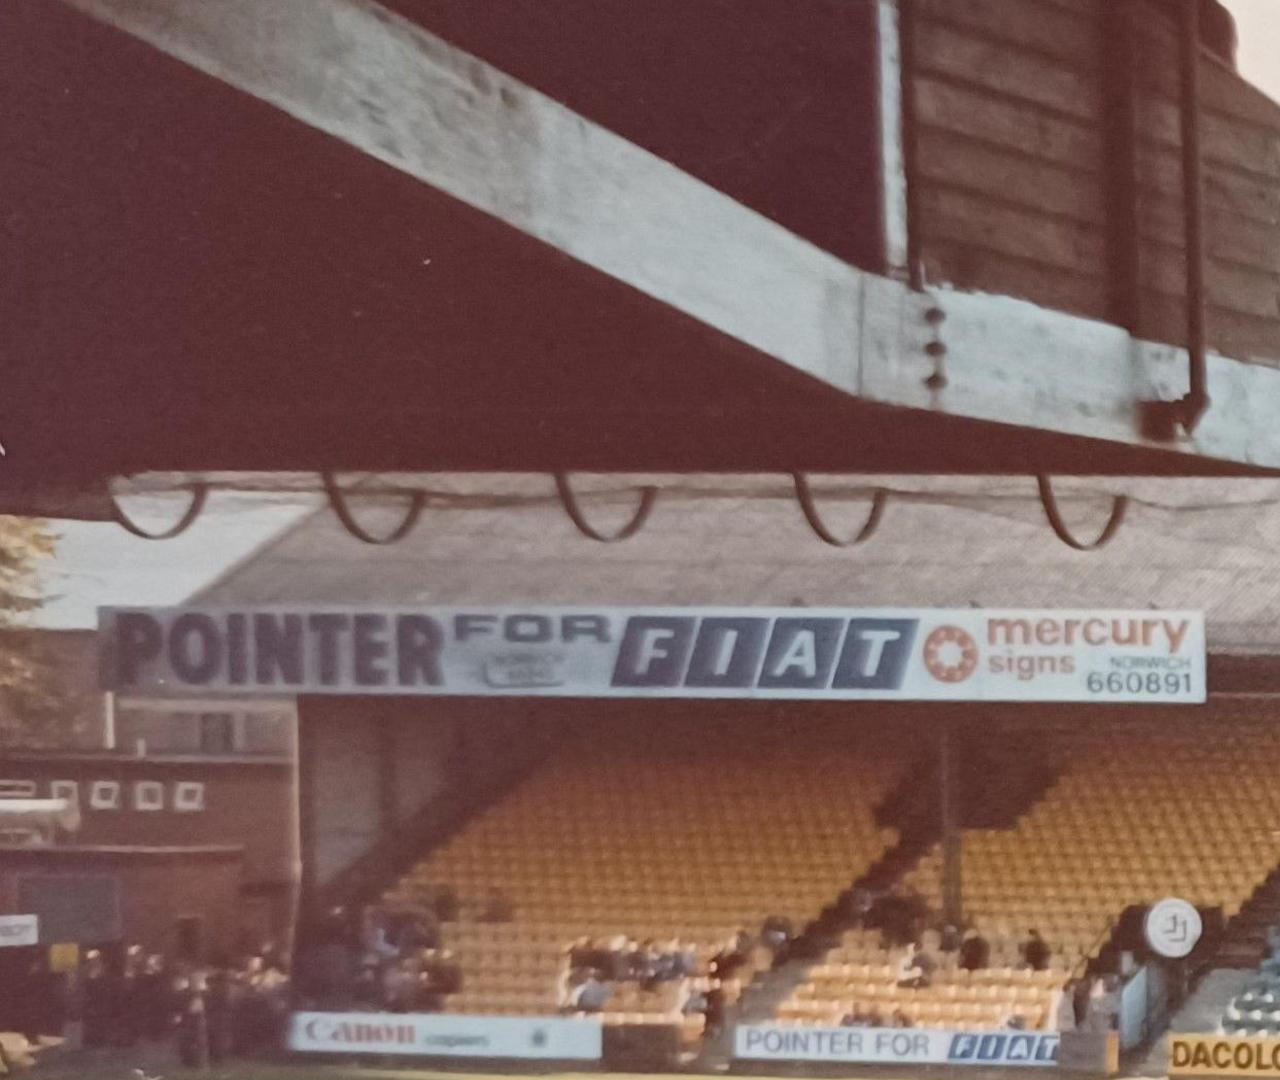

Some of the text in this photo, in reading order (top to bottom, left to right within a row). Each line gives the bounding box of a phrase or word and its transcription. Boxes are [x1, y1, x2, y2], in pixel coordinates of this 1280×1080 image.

[987, 618, 1189, 653] mercury
[114, 613, 444, 686] POINTER
[455, 614, 612, 643] FOR
[620, 621, 910, 684] FIAT
[1110, 656, 1191, 669] NORWICH
[988, 650, 1075, 681] signs
[1087, 672, 1191, 694] 660891
[306, 1018, 416, 1045] Canon
[746, 1029, 863, 1055] POINTER
[875, 1032, 931, 1056] FOR
